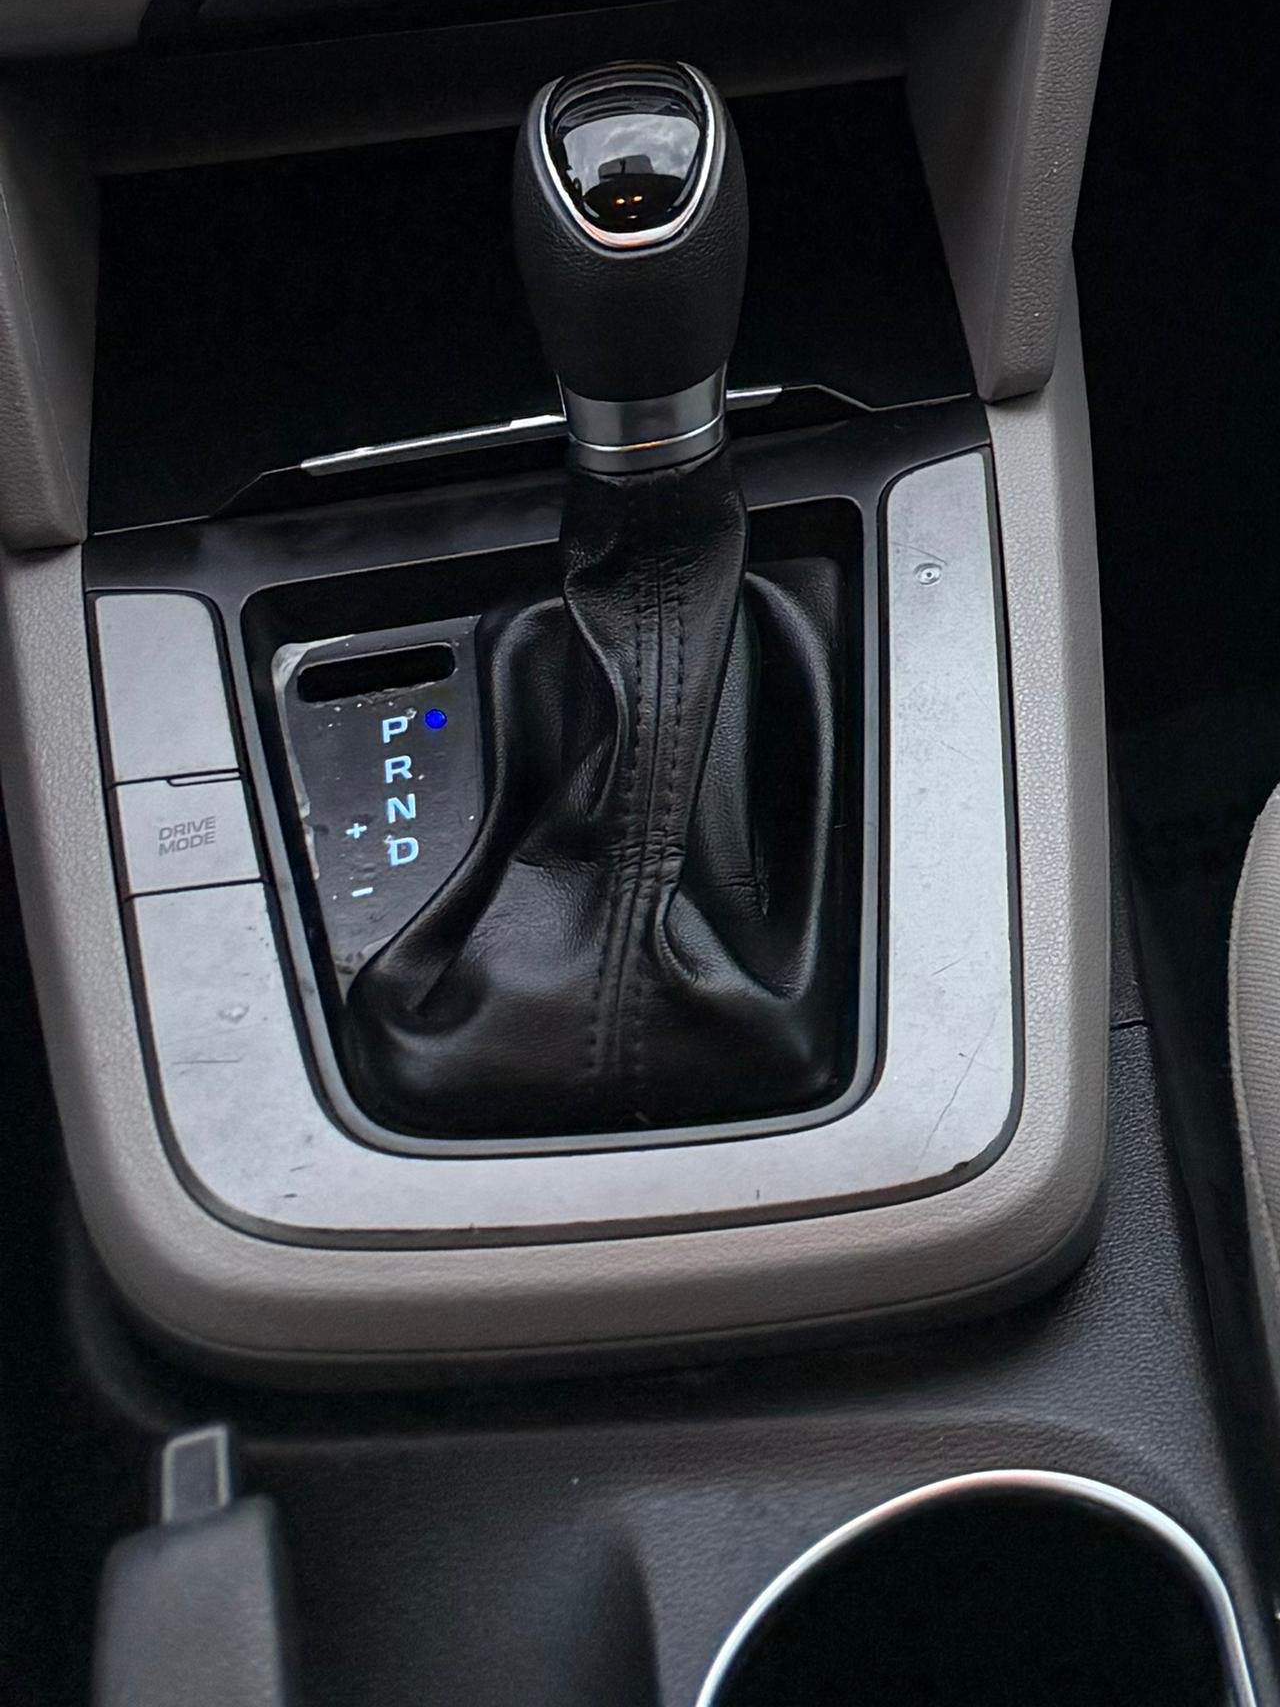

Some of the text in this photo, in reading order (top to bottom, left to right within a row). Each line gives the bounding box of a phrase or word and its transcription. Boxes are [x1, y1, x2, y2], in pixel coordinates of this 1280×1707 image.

[381, 716, 408, 743] P
[384, 755, 412, 783] R
[387, 793, 416, 823] N
[158, 816, 216, 842] DRIVE
[158, 832, 216, 857] MODE
[388, 836, 419, 867] D
